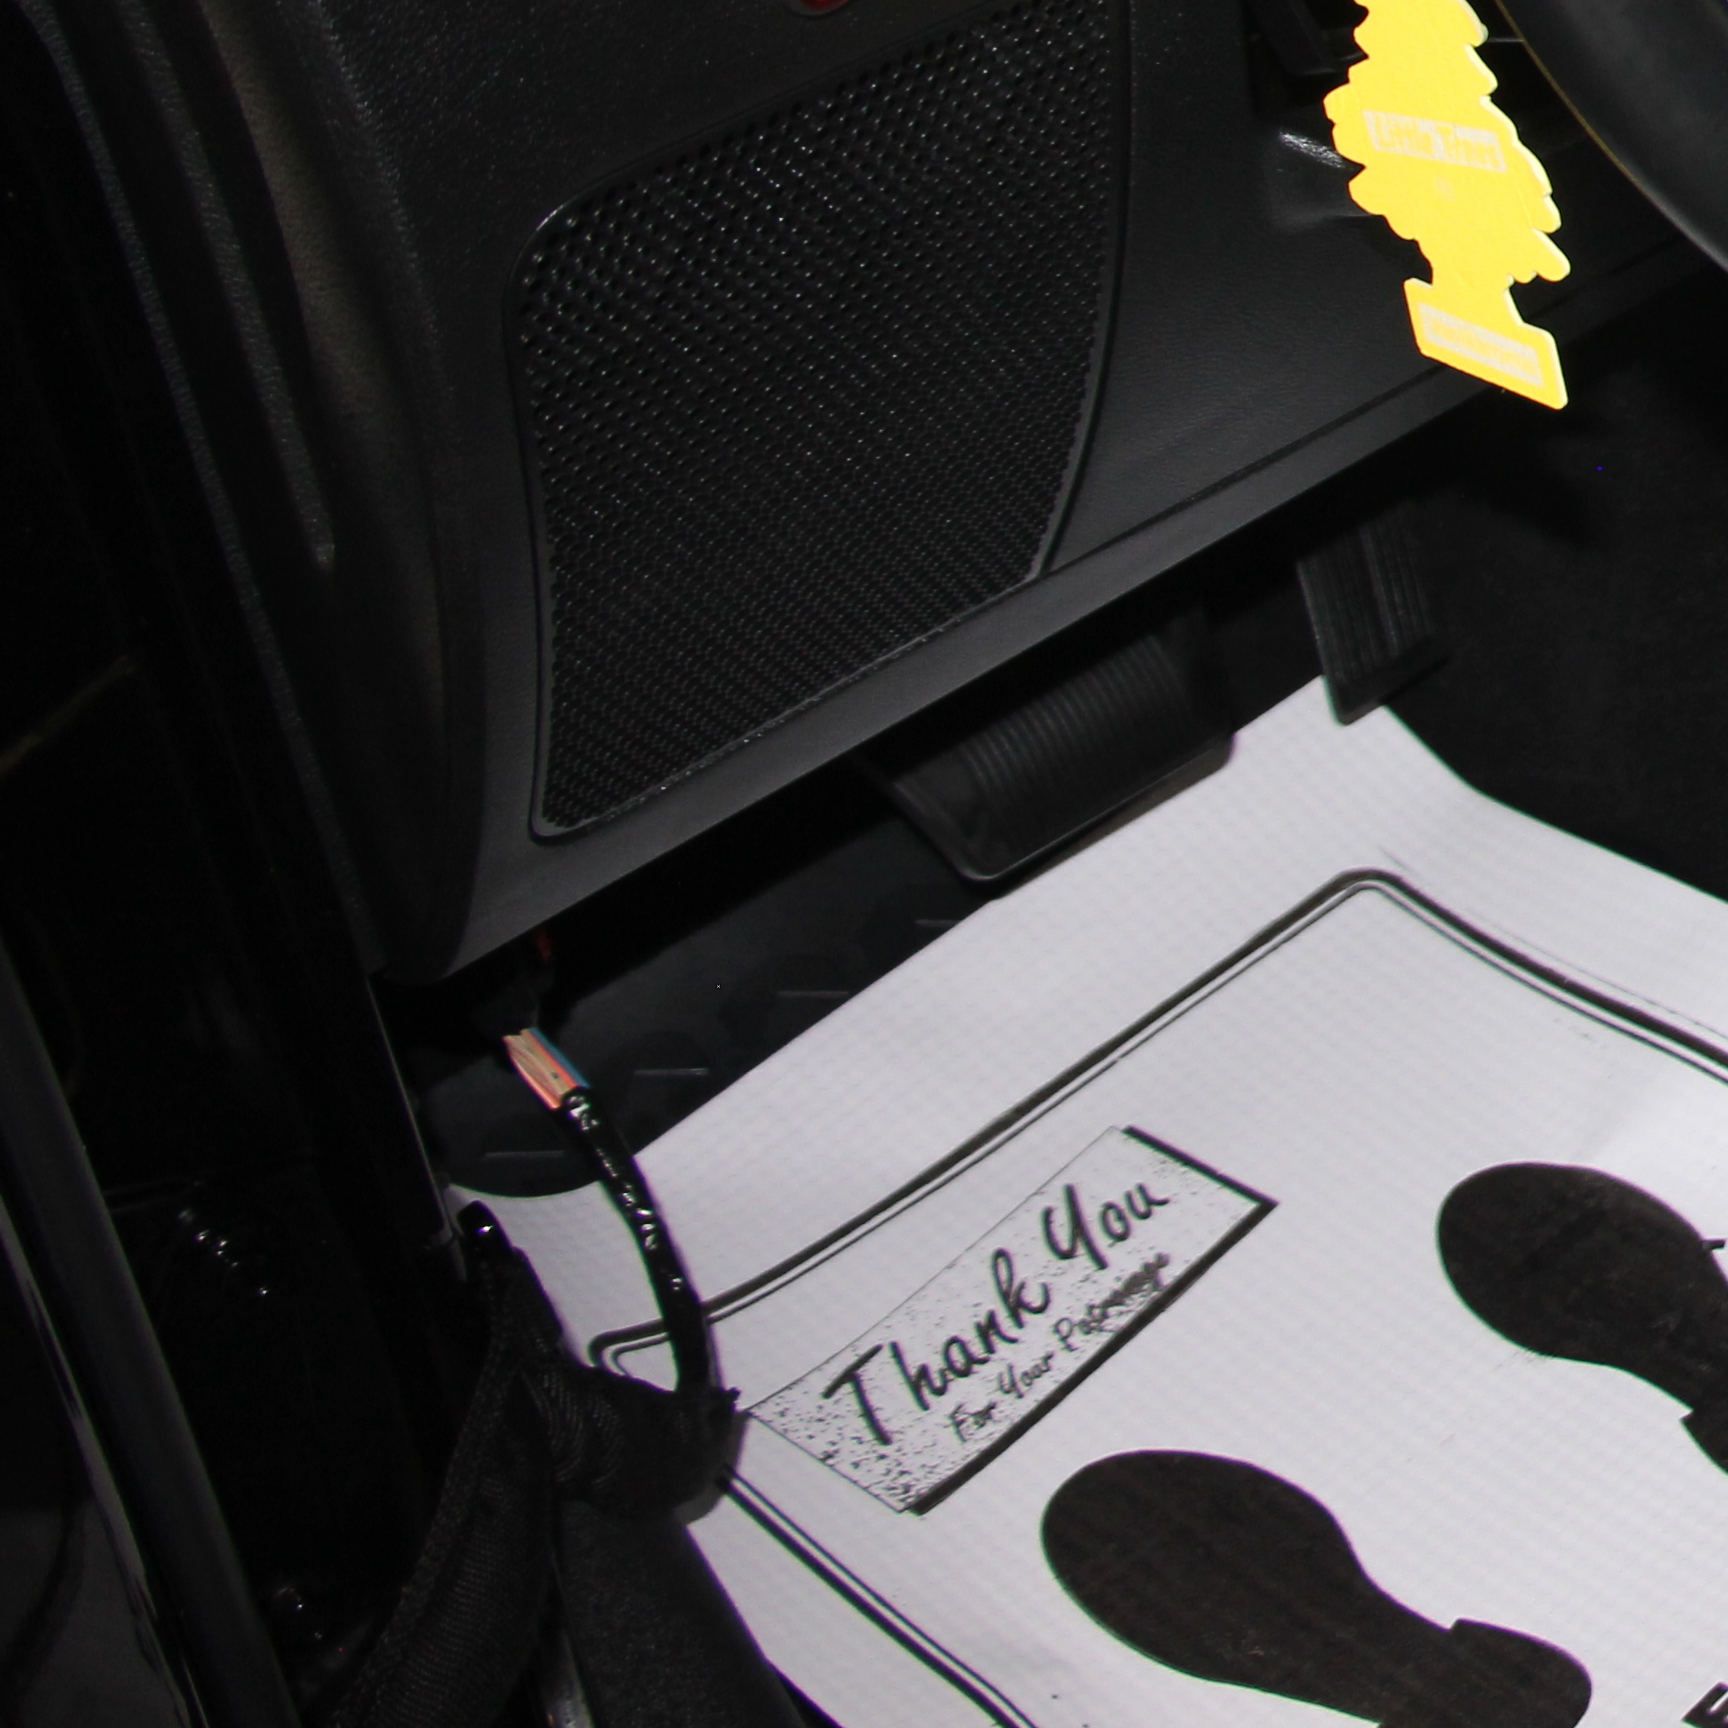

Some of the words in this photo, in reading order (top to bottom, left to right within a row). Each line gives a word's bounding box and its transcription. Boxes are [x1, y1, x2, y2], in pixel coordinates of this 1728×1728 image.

[821, 1247, 1051, 1446] Thank
[1041, 1183, 1170, 1271] You
[998, 1350, 1055, 1399] Your
